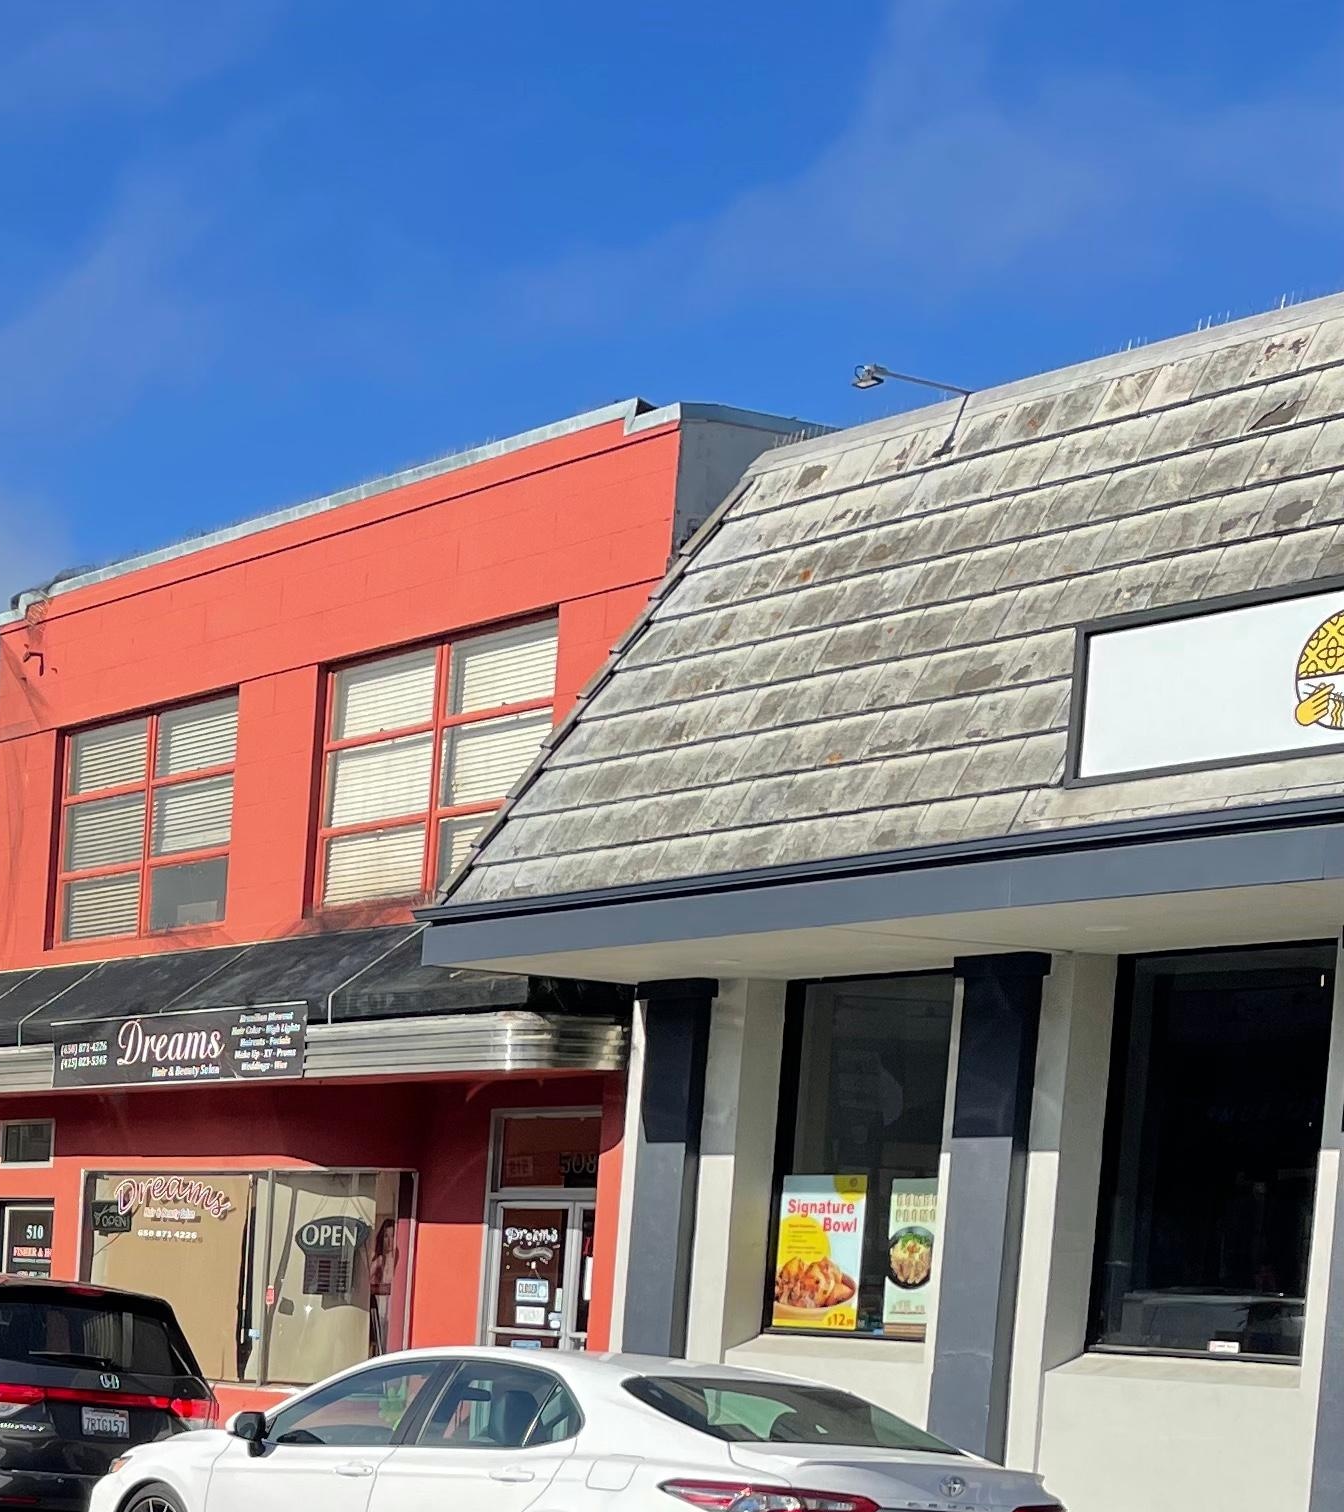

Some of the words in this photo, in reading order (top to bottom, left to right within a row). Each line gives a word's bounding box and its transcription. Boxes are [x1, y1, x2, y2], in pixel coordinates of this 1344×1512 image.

[117, 1019, 226, 1066] Dreams
[151, 1066, 168, 1077] Hair
[168, 1065, 174, 1076] &
[175, 1065, 200, 1078] Beauty
[199, 1063, 220, 1076] Salon
[561, 1152, 597, 1175] 508
[114, 1176, 232, 1218] Dreams
[787, 1198, 855, 1218] Signature
[25, 1224, 44, 1240] 510
[137, 1229, 155, 1237] 650
[156, 1230, 172, 1238] 871
[173, 1231, 198, 1239] 4226
[823, 1217, 858, 1233] Bowl
[301, 1223, 358, 1247] OPEN
[13, 1246, 37, 1257] FISHER
[37, 1247, 44, 1257] &
